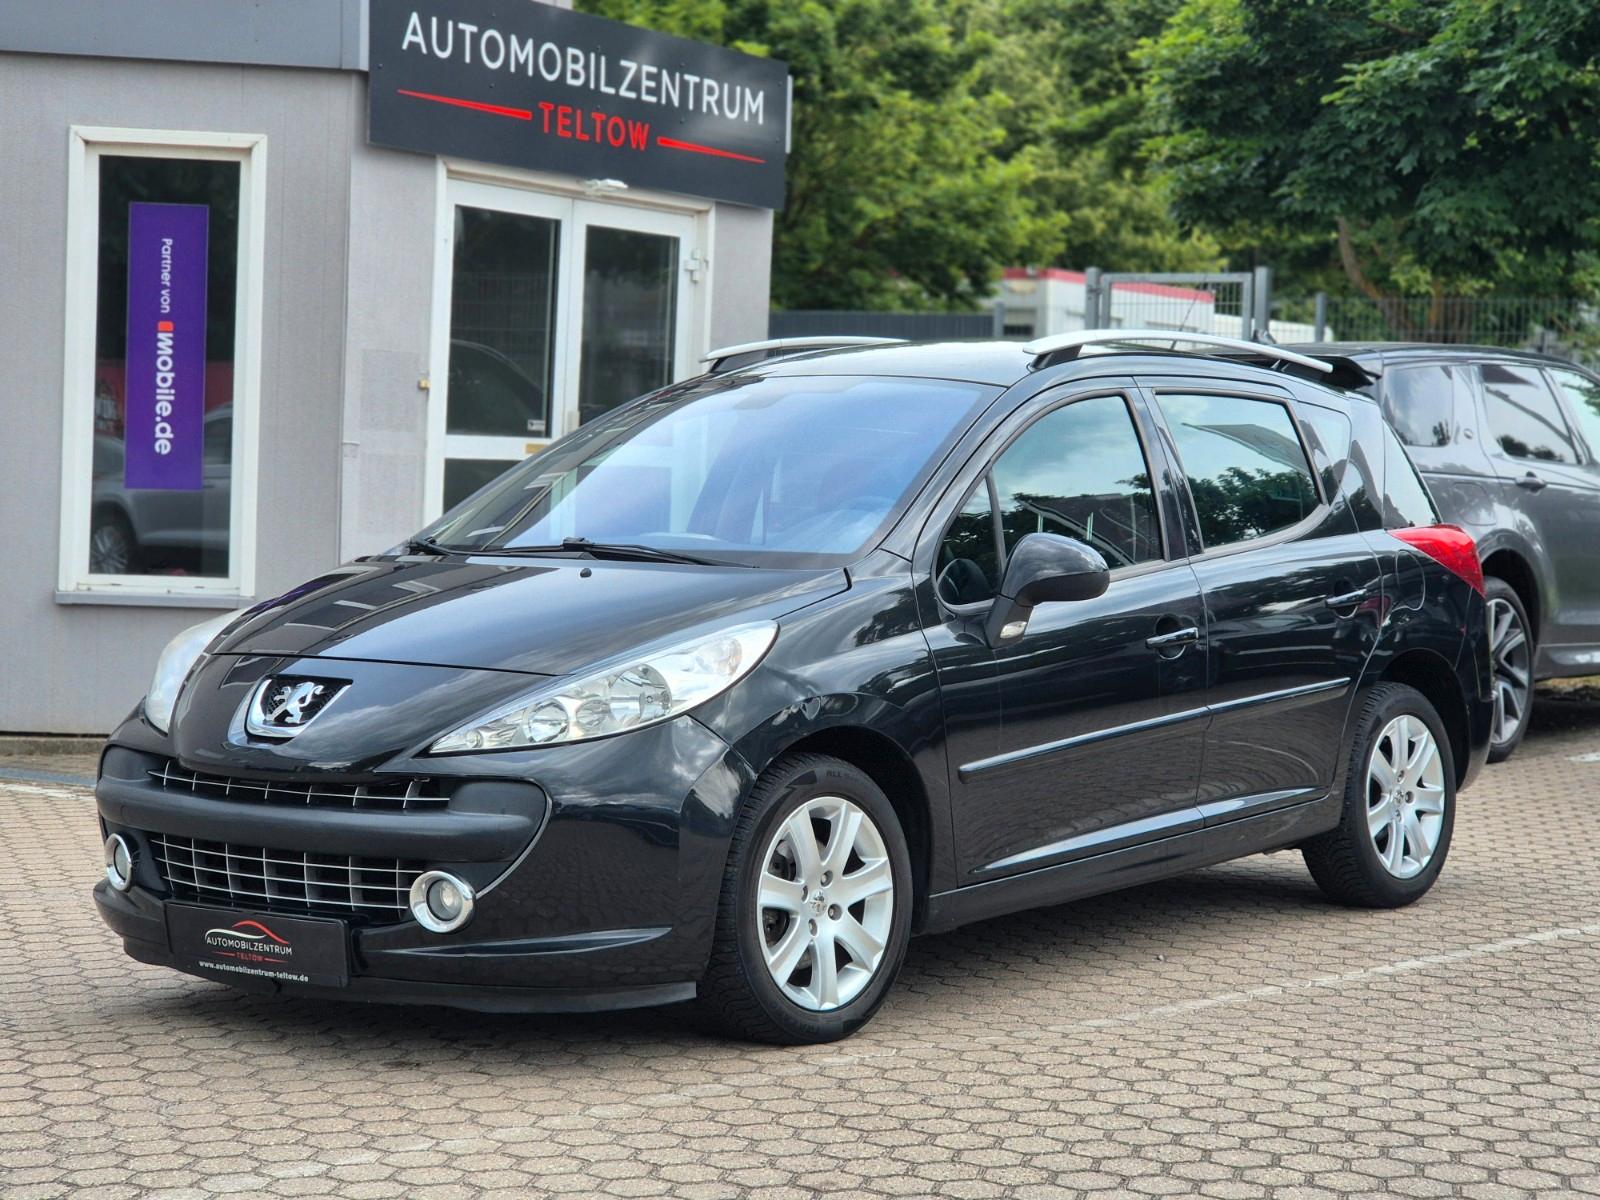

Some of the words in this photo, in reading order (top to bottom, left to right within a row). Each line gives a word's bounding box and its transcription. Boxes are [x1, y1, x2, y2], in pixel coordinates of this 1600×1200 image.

[402, 11, 765, 125] AUTOMOBILZENTRUM
[538, 102, 650, 151] TELTOW
[160, 237, 173, 287] Partner
[159, 289, 171, 314] von
[154, 332, 176, 455] mobile.de
[206, 936, 293, 956] AUTOMOBILZENTRUM
[236, 952, 264, 962] TELTOW
[198, 960, 309, 983] www.automobilzentrum-teltow.de
